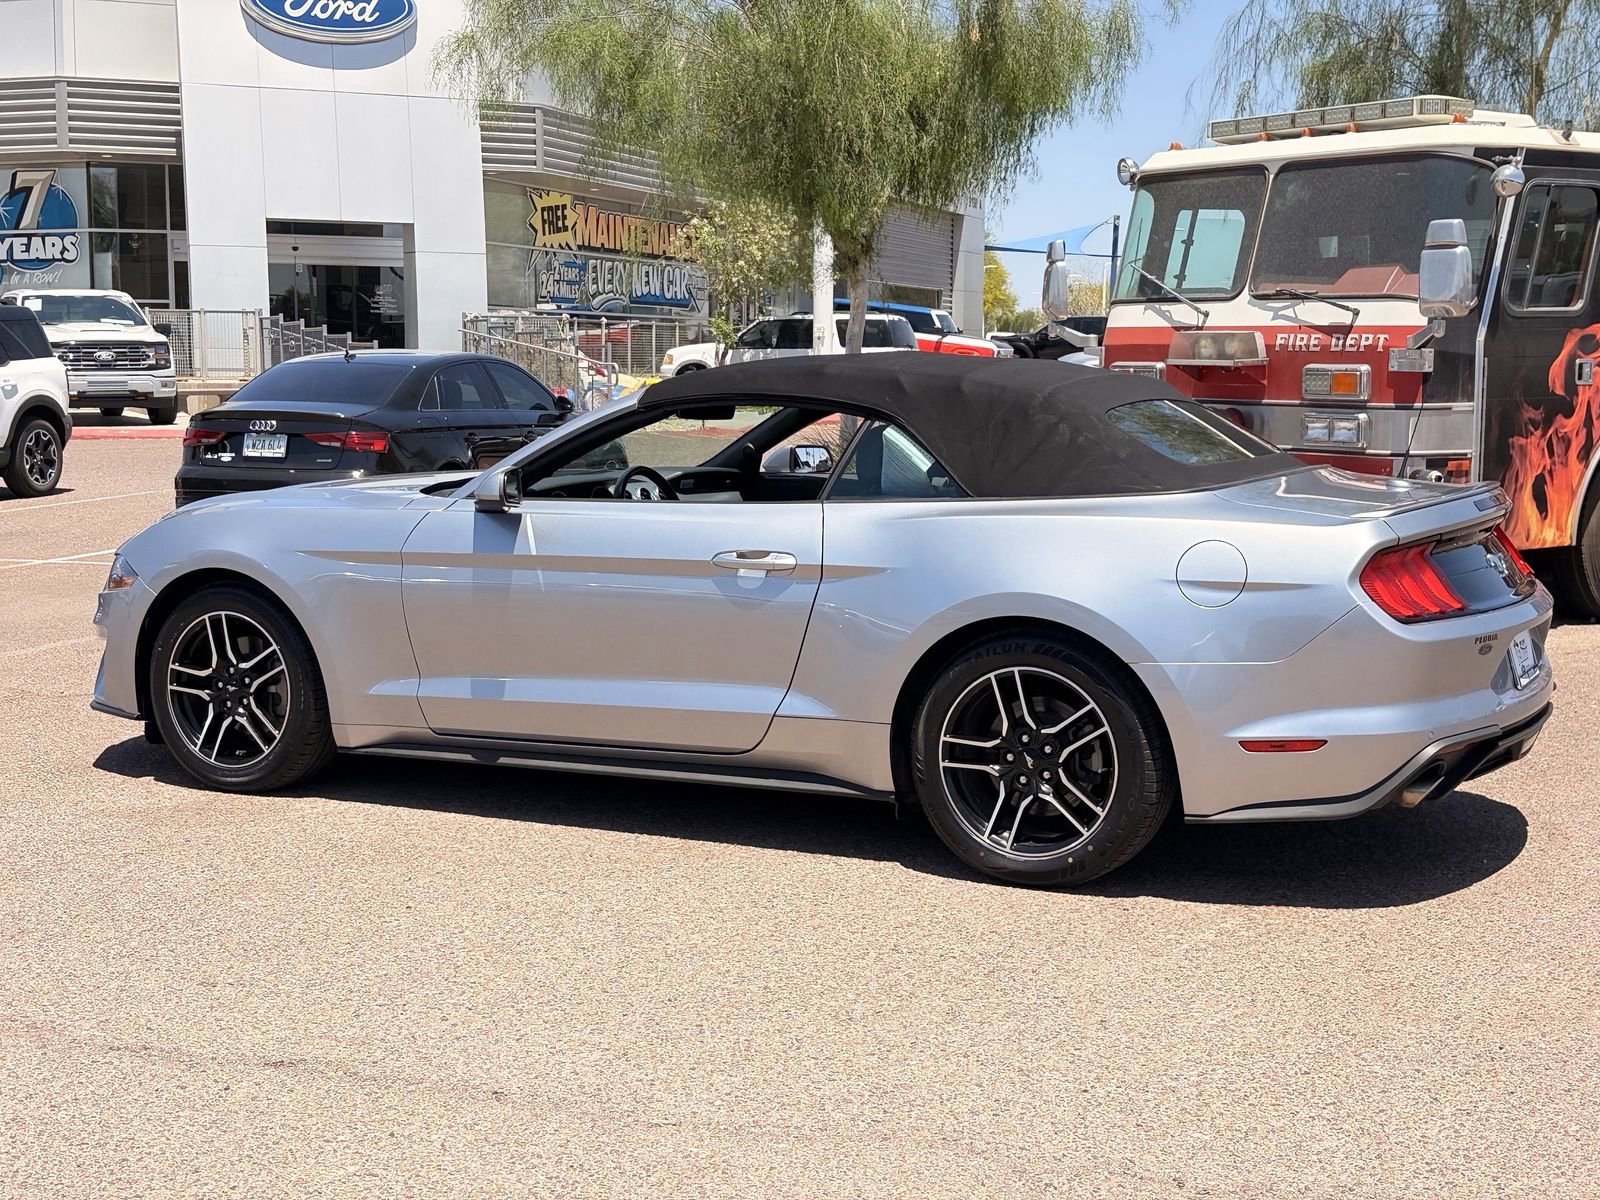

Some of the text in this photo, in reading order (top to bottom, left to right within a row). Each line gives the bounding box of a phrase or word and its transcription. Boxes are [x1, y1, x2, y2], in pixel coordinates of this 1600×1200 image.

[541, 204, 569, 237] FREE
[574, 203, 699, 260] MAINTENANC
[0, 234, 79, 261] YEARS
[588, 259, 630, 300] EVERY
[632, 262, 661, 298] NEW
[663, 266, 690, 300] CAR
[1275, 333, 1389, 352] FIRE DEPT
